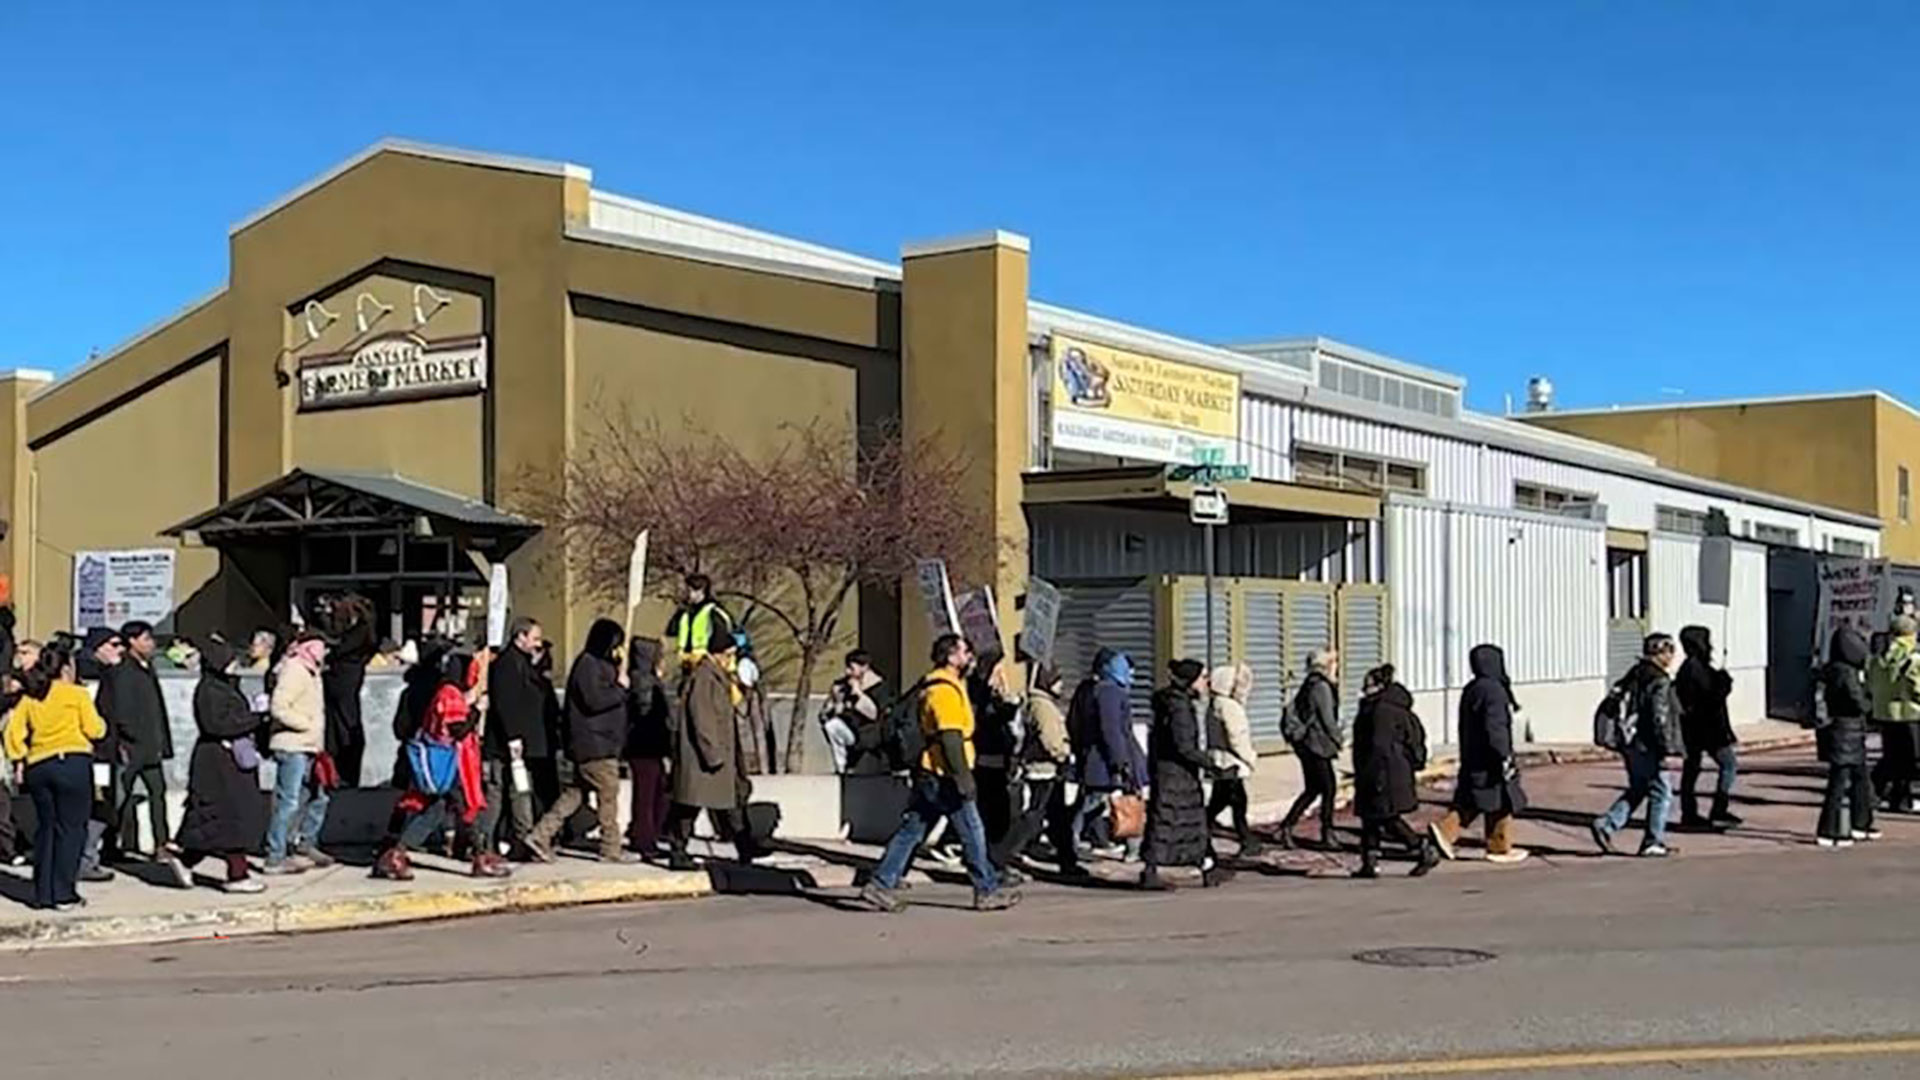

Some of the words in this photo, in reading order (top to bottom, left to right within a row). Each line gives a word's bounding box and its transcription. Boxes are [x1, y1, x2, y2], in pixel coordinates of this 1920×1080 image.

[394, 356, 479, 386] MARKET
[1112, 374, 1182, 403] SATURDAY
[1183, 388, 1233, 414] MARKET
